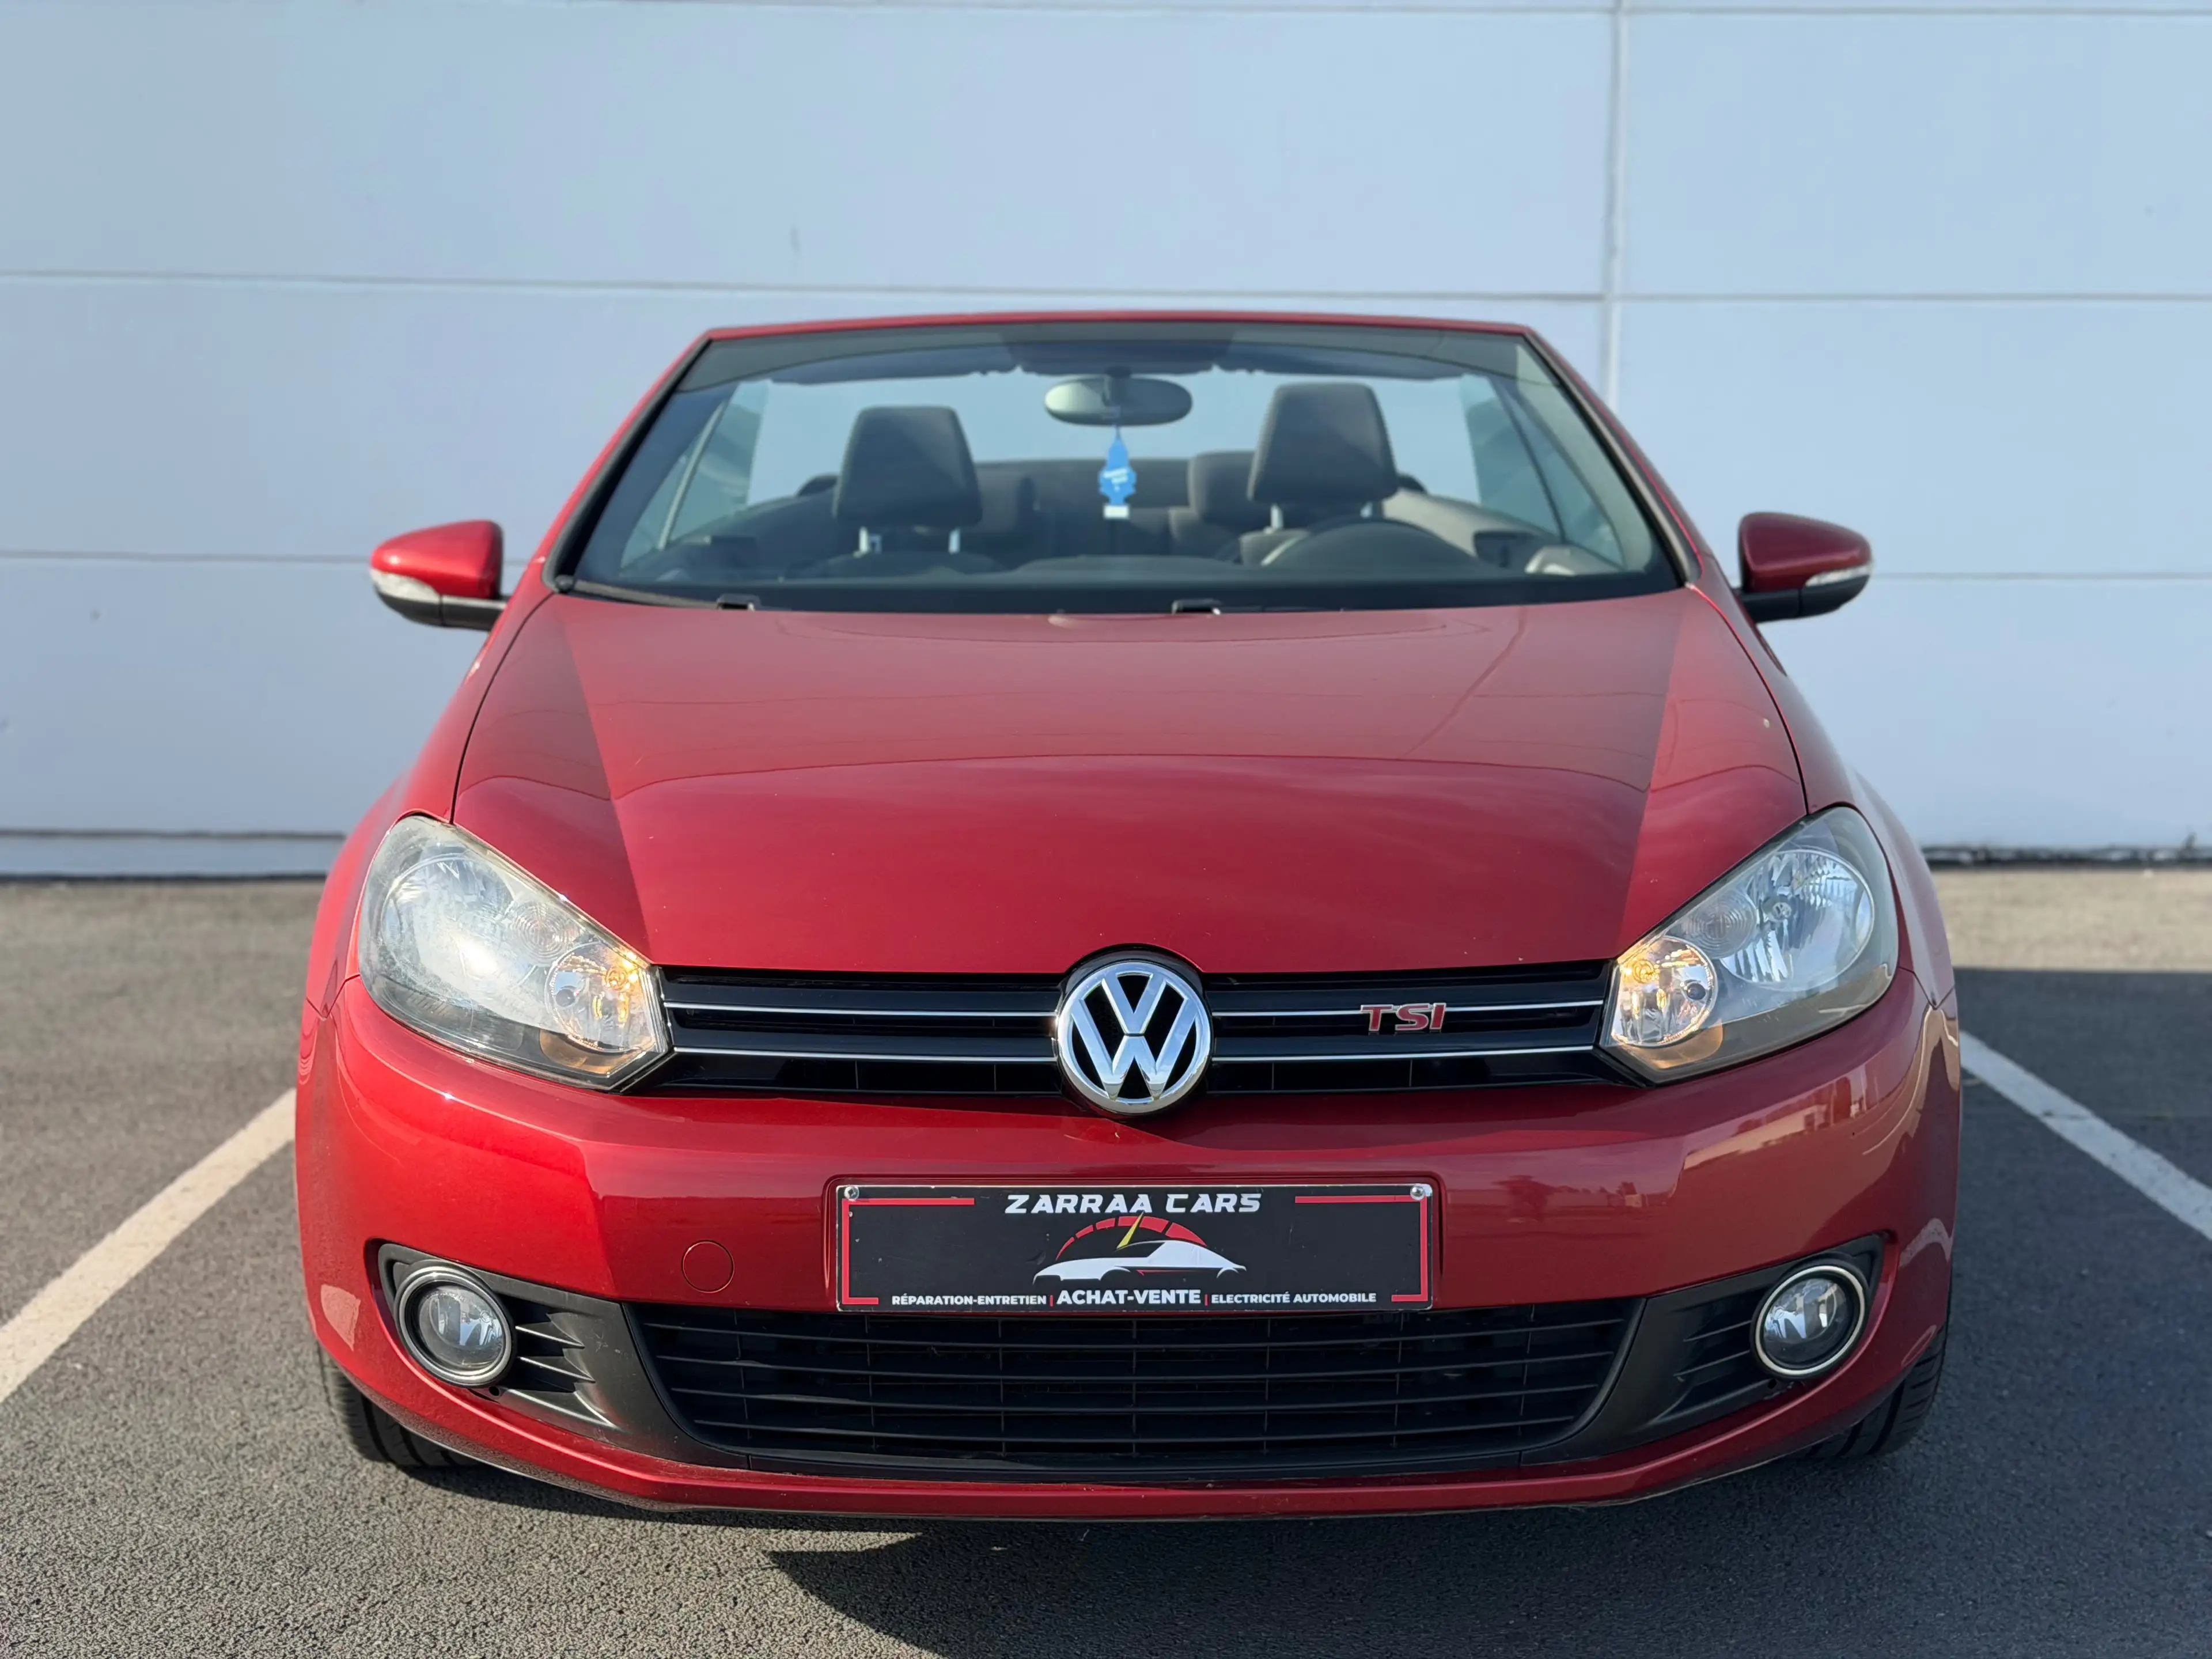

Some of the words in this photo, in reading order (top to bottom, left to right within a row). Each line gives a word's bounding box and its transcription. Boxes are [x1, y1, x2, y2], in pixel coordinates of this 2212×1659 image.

[1360, 1002, 1446, 1031] TSI
[1067, 969, 1202, 1103] VW
[1005, 1194, 1153, 1214] ZARRAA
[1165, 1193, 1262, 1213] CARS
[892, 1293, 1047, 1305] RÉPARATION-ENTRETIEN
[1056, 1289, 1202, 1305] ACHAT-VENTE
[1211, 1291, 1291, 1304] ELECTRICITÉ
[1293, 1292, 1377, 1304] AUTOMOBILE
